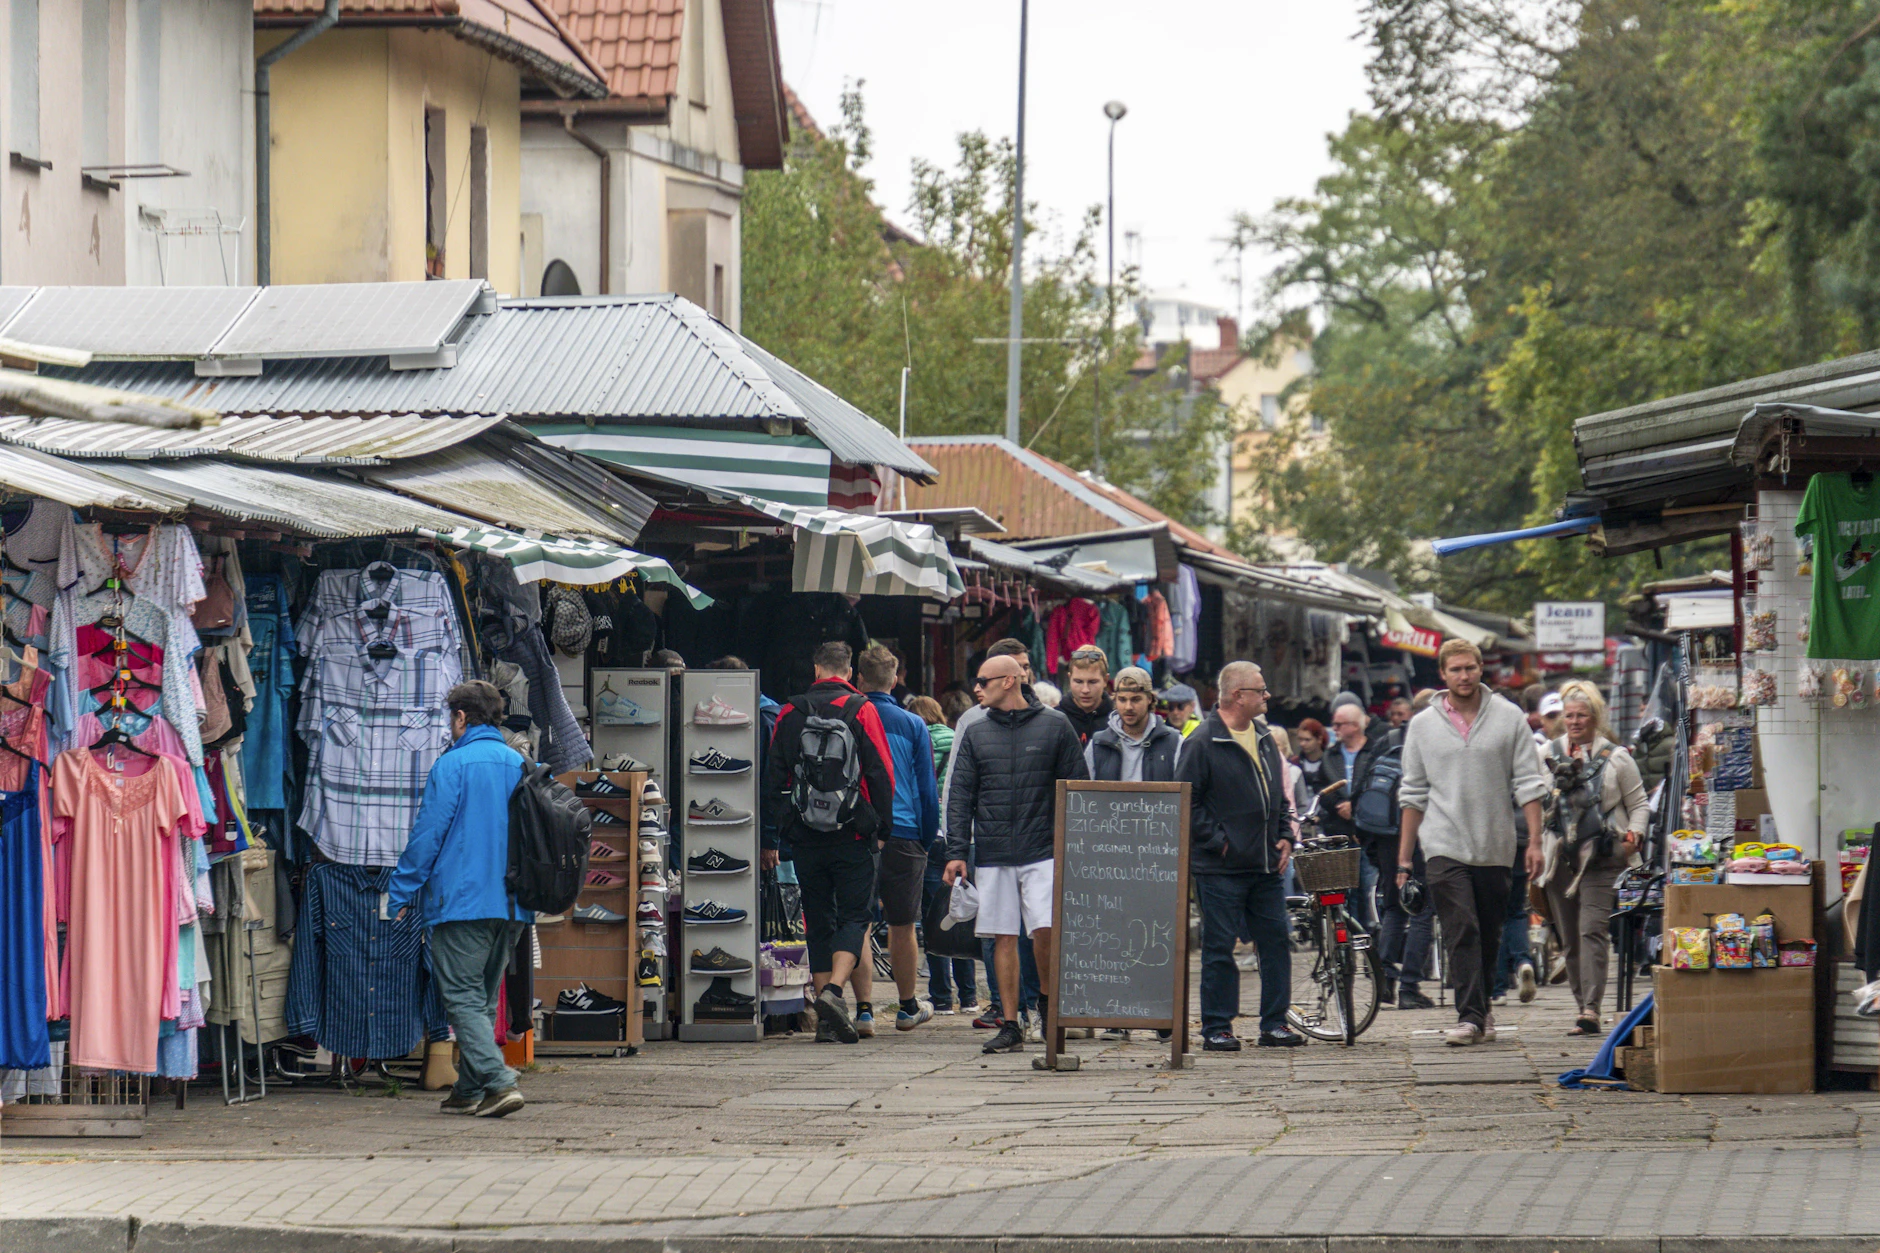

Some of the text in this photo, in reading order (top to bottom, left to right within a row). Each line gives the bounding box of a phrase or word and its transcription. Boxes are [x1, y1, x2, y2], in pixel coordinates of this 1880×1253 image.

[1547, 604, 1593, 617] Jeans
[1388, 629, 1437, 653] GRILL
[1066, 792, 1098, 815] Die
[1069, 818, 1173, 837] ZIGARETTEN
[1067, 838, 1085, 854] mit
[1064, 891, 1123, 911] Pall Mall
[1066, 912, 1102, 930] West
[1065, 952, 1130, 971] Marlboro
[1064, 971, 1131, 985] CHESTERFIELD
[1064, 983, 1087, 997] LM
[1061, 1000, 1100, 1017] Lucky
